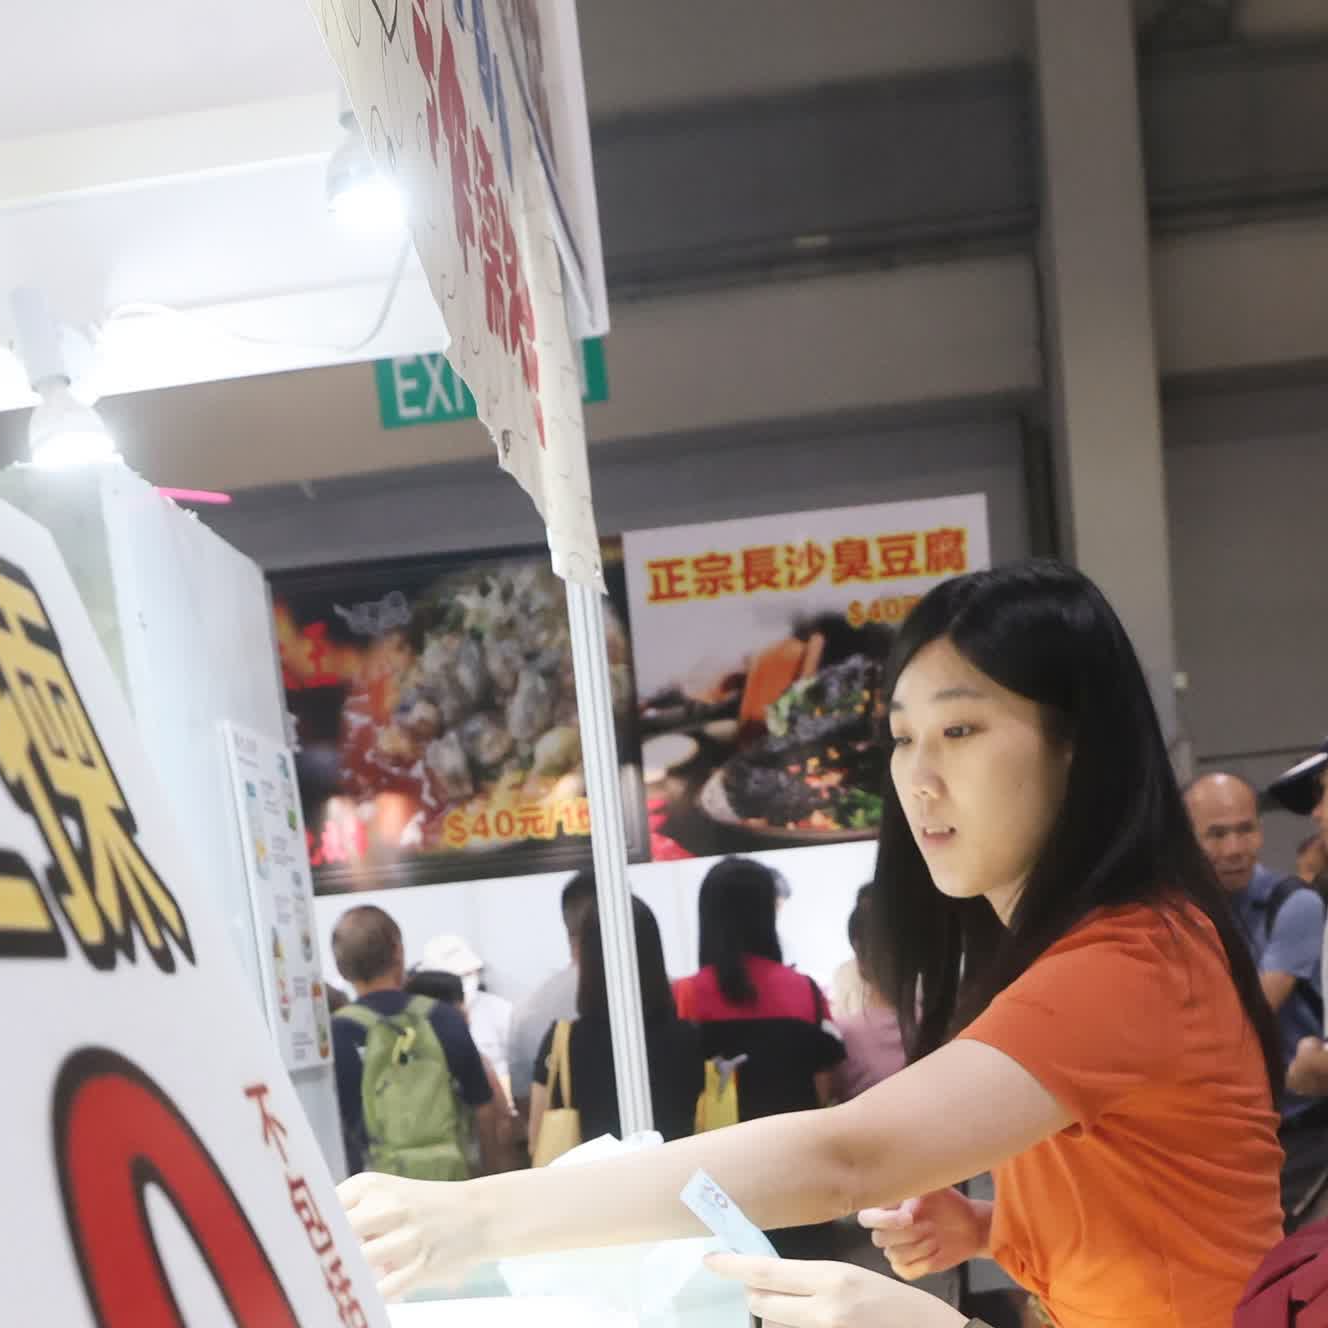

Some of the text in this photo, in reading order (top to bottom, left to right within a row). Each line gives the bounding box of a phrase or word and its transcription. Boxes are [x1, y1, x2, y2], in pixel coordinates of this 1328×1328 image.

[392, 334, 466, 419] EXI
[644, 526, 968, 604] 正宗長沙臭豆腐
